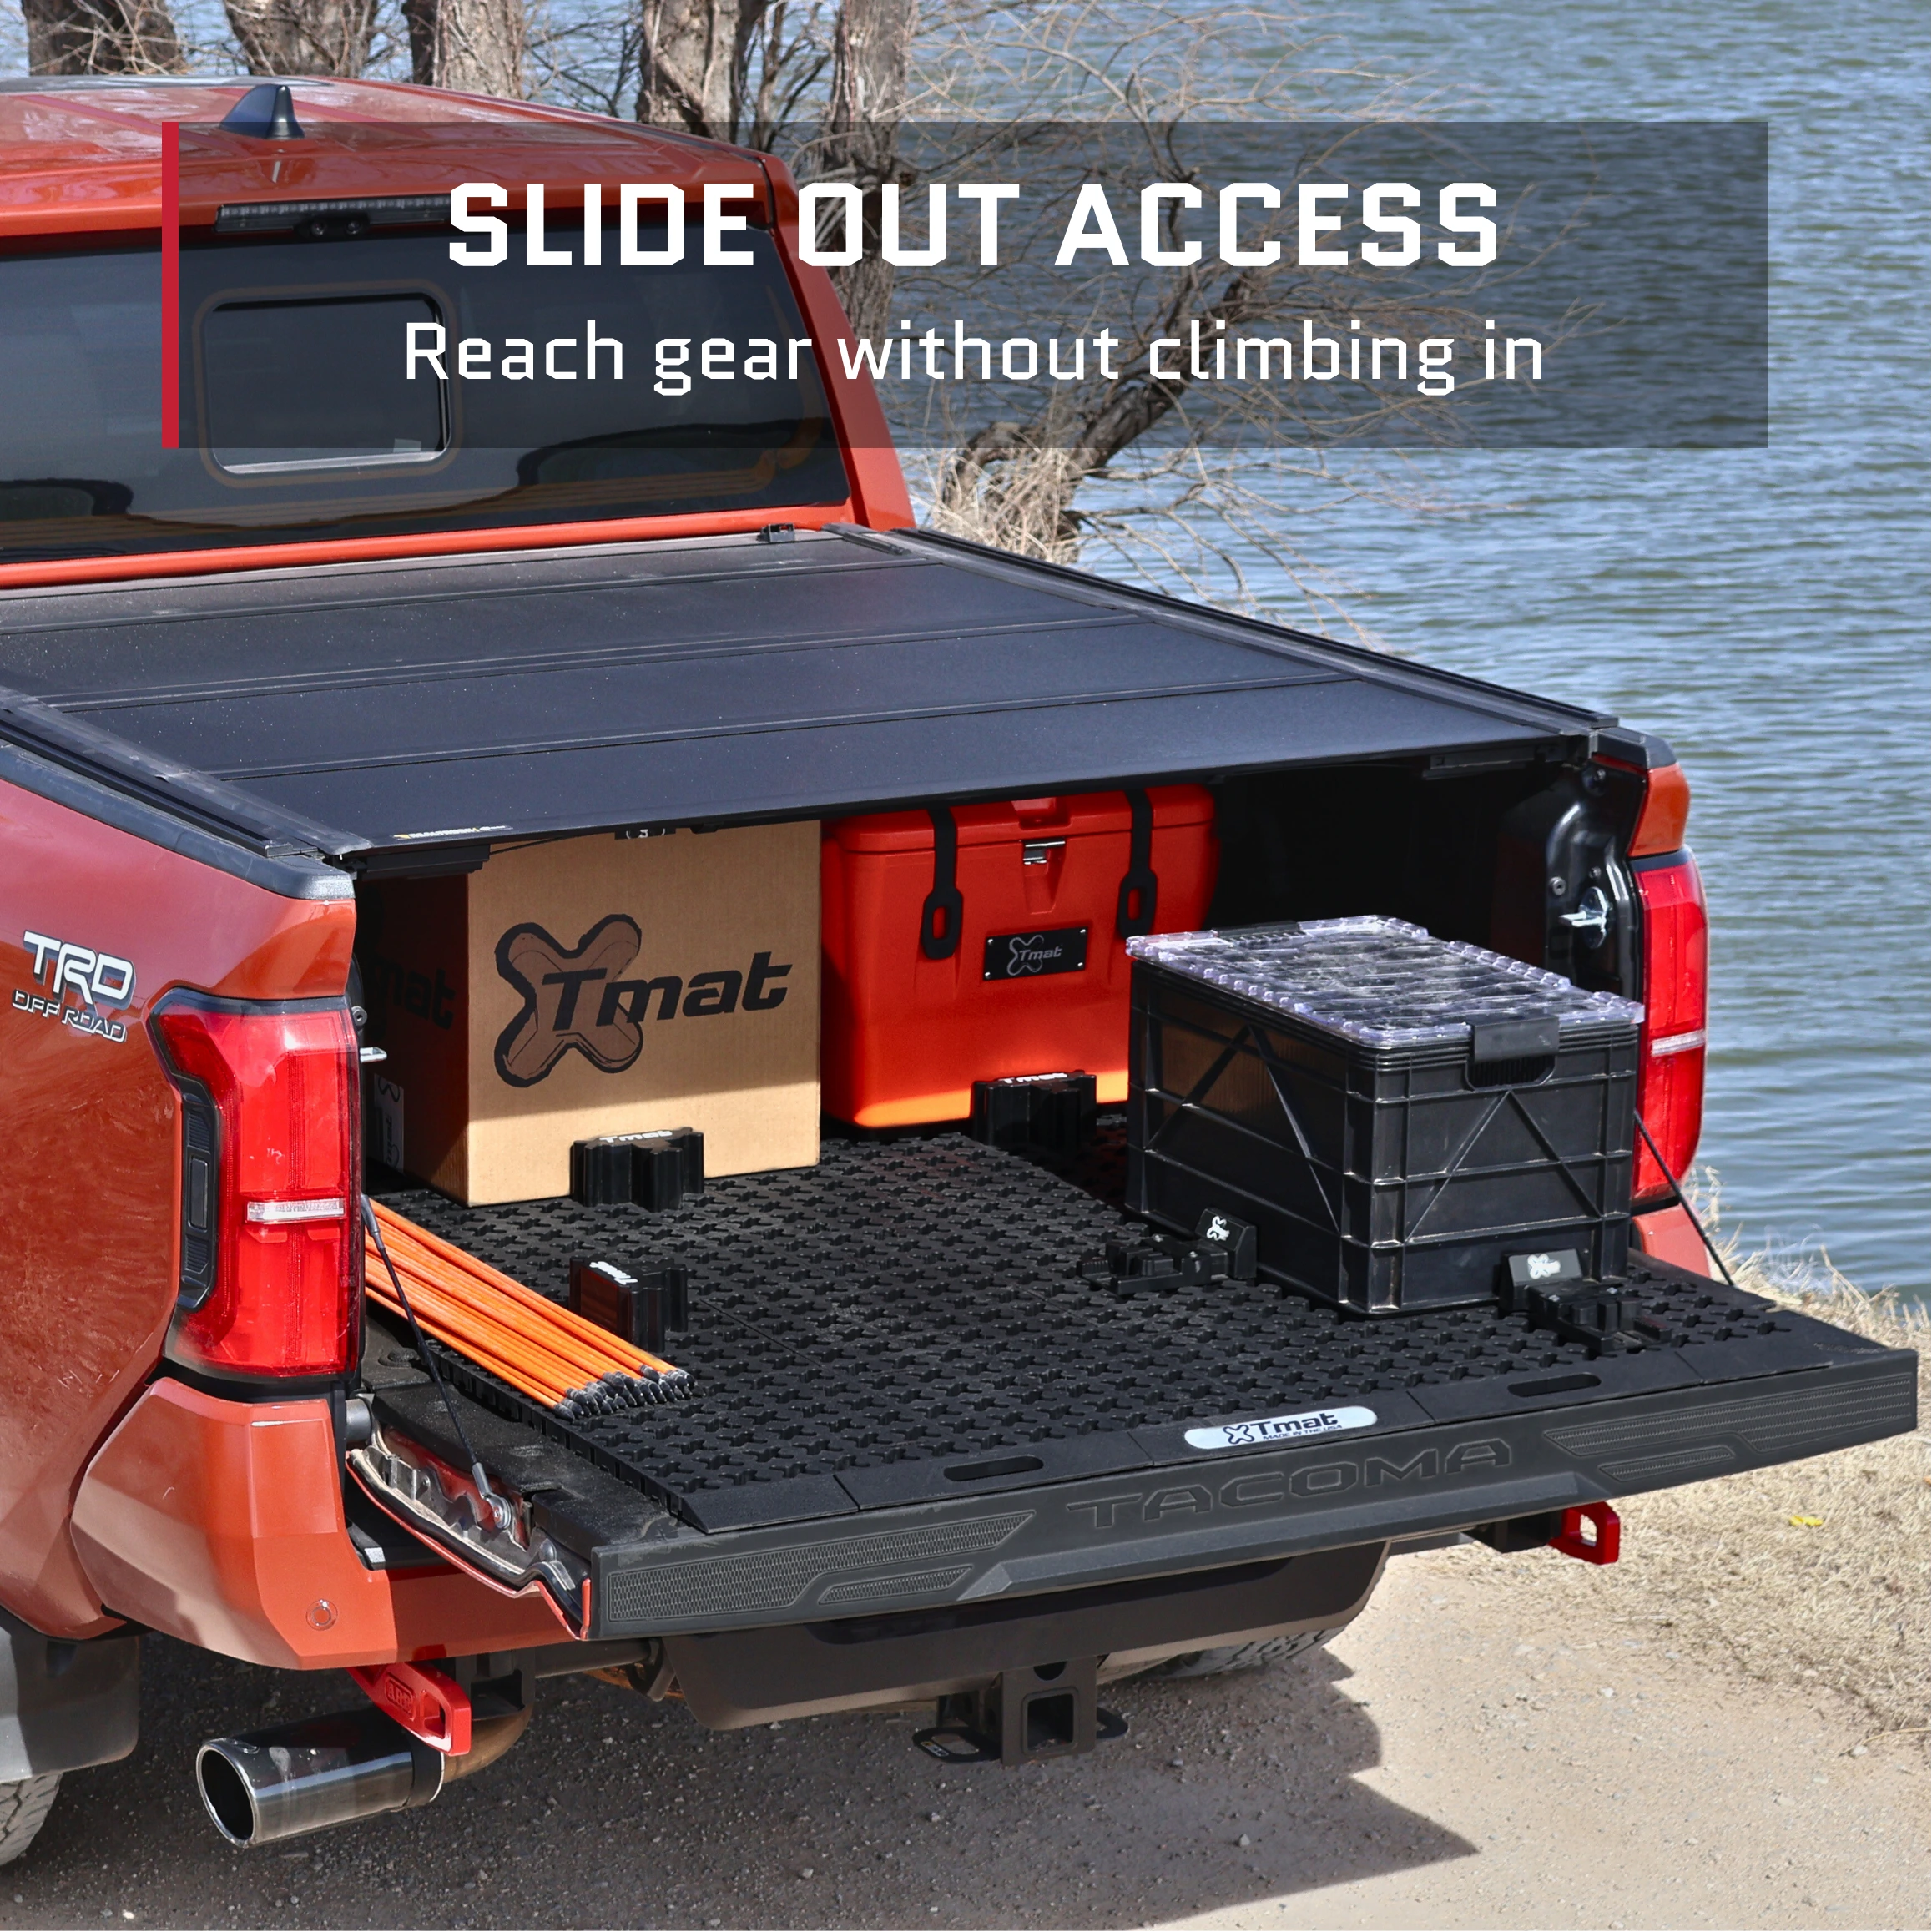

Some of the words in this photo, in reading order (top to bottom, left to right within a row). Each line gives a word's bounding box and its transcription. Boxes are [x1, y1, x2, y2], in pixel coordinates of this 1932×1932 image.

[23, 931, 135, 1007] TRD
[13, 989, 61, 1018] OFF
[62, 1006, 128, 1043] ROAD
[1067, 1438, 1512, 1529] TACOMA
